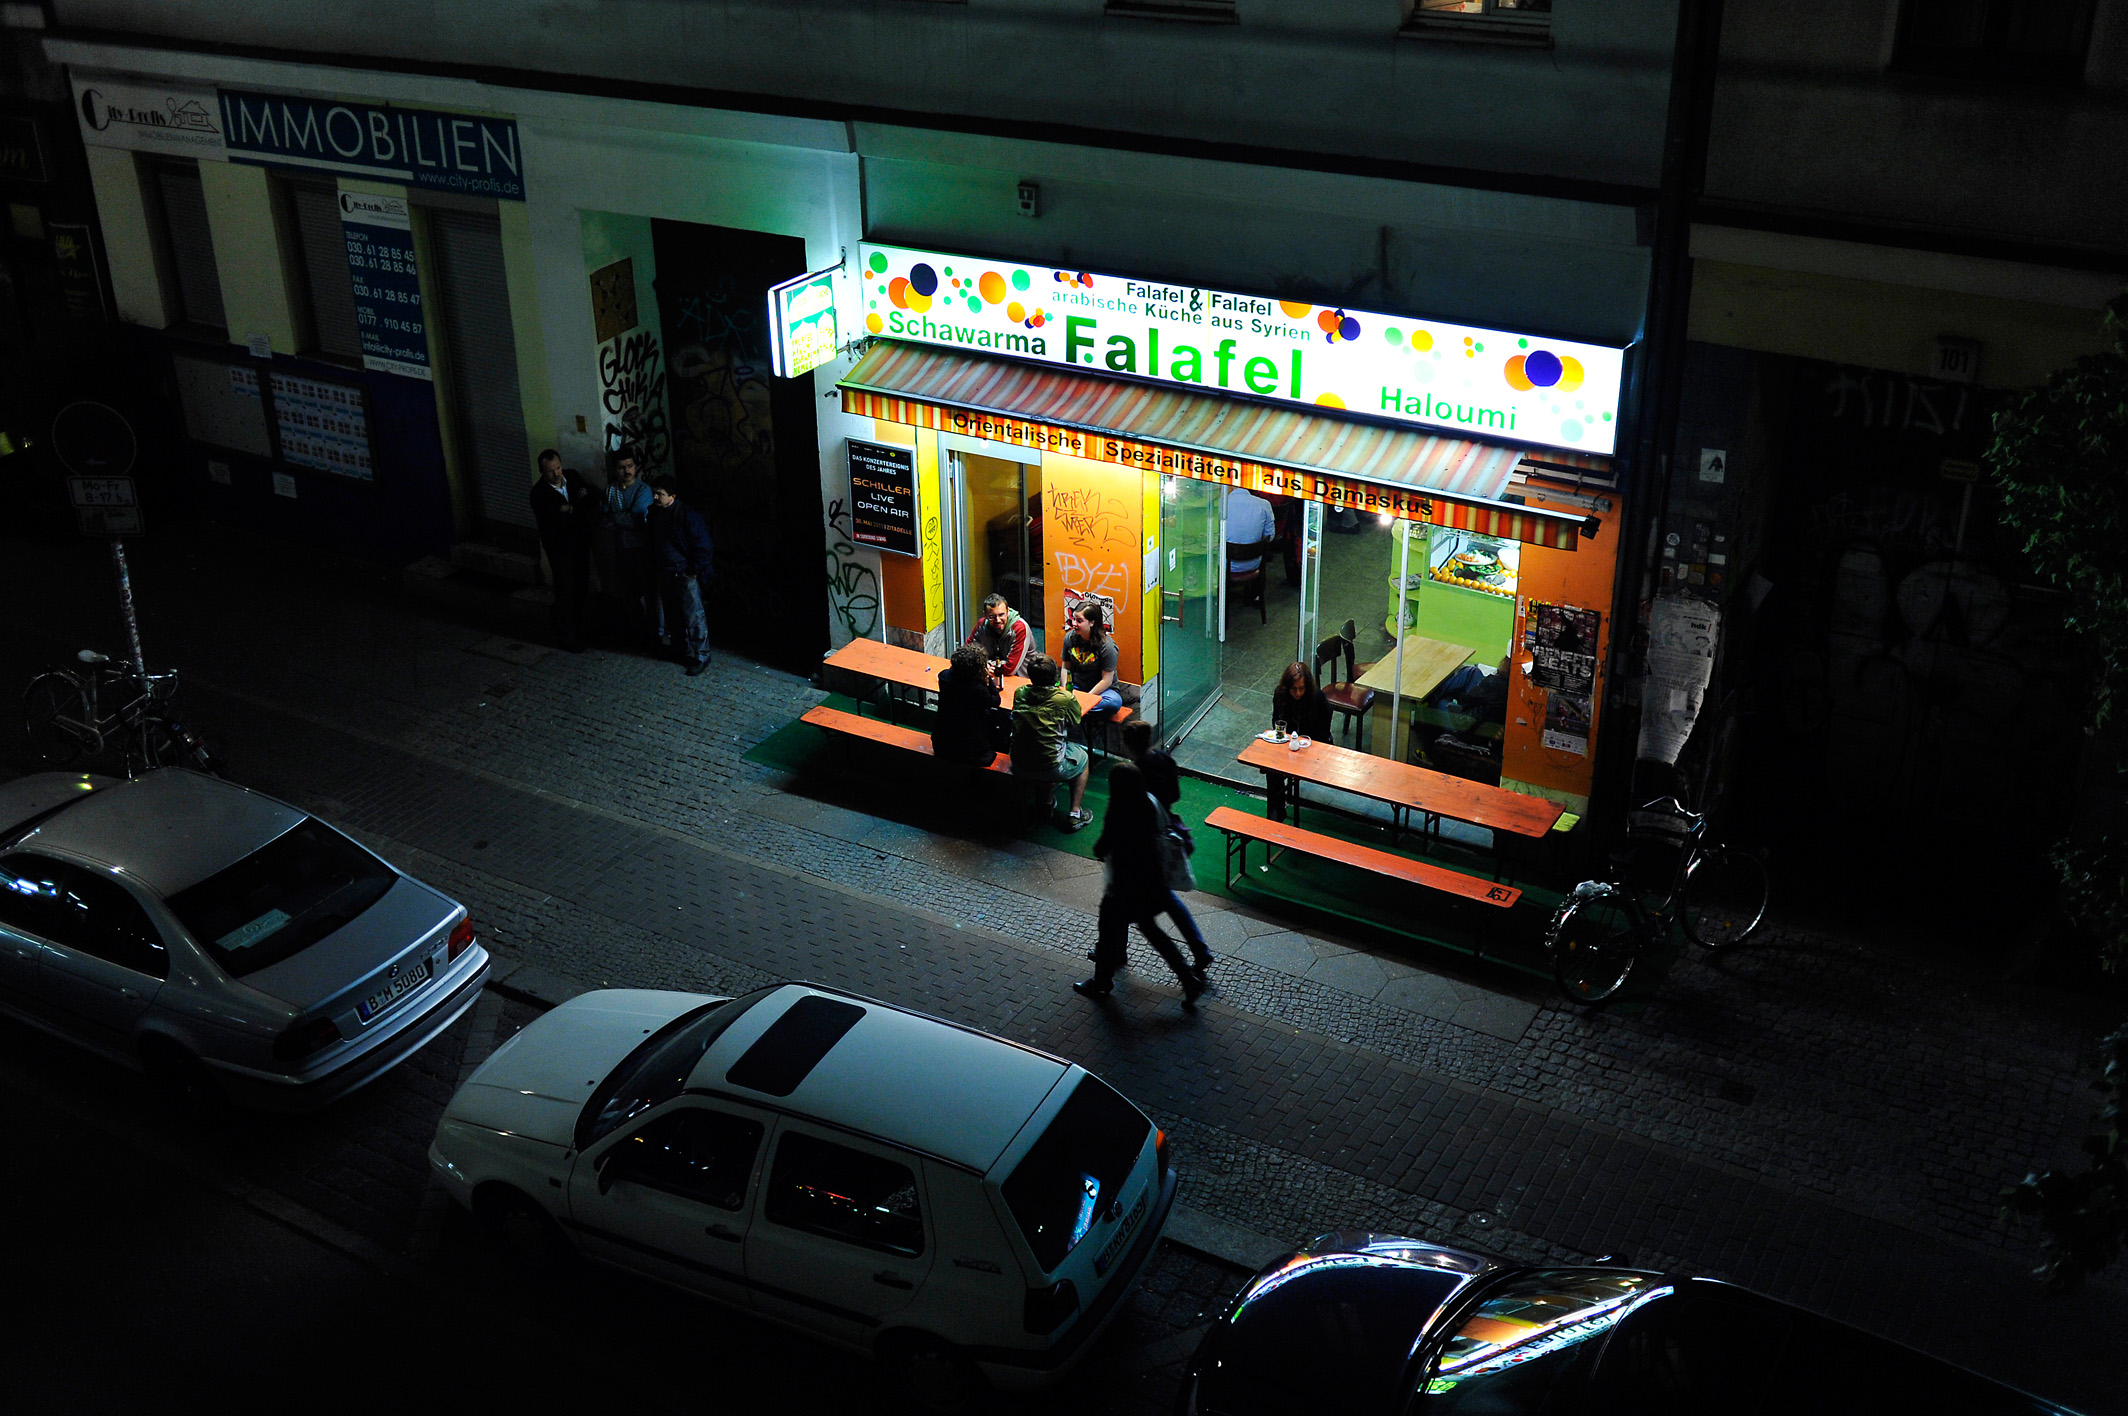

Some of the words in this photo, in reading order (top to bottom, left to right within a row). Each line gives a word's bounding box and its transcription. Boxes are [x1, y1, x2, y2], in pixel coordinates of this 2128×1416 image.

[224, 95, 518, 177] IMMOBILIEN
[419, 171, 519, 195] www.city-profis.de
[379, 246, 390, 258] 28
[391, 247, 402, 260] 85
[404, 250, 415, 262] 45
[381, 260, 391, 271] 28
[393, 261, 404, 273] 85
[406, 263, 416, 275] 46
[352, 275, 364, 284] FAX
[385, 289, 396, 301] 28
[398, 291, 408, 303] 85
[410, 294, 420, 305] 47
[1127, 282, 1184, 303] Falafel
[1190, 288, 1203, 311] &
[1212, 294, 1271, 316] Falafel
[358, 314, 377, 326] 0177
[400, 321, 411, 333] 45
[412, 323, 422, 334] 87
[1052, 291, 1137, 314] arabische
[1145, 303, 1202, 324] Küche
[1211, 316, 1243, 330] aus
[1251, 319, 1310, 341] Syrien
[889, 310, 1047, 356] Schawarma
[1941, 349, 1969, 373] 101
[1381, 386, 1516, 430] Haloumi
[953, 412, 1082, 450] Orientalische
[852, 454, 863, 462] DAS
[863, 457, 910, 471] KONZERTEREIGNIS
[877, 466, 897, 475] JAHRES
[853, 477, 911, 496] SCHILLER
[1105, 441, 1240, 480] Spezialitäten
[1263, 472, 1302, 491] aus
[1313, 479, 1433, 516] Damaskus
[870, 492, 895, 504] LIVE
[857, 501, 888, 514] OPEN
[890, 508, 910, 519] AIR
[1537, 656, 1592, 678] BEATS
[394, 965, 425, 993] 5080
